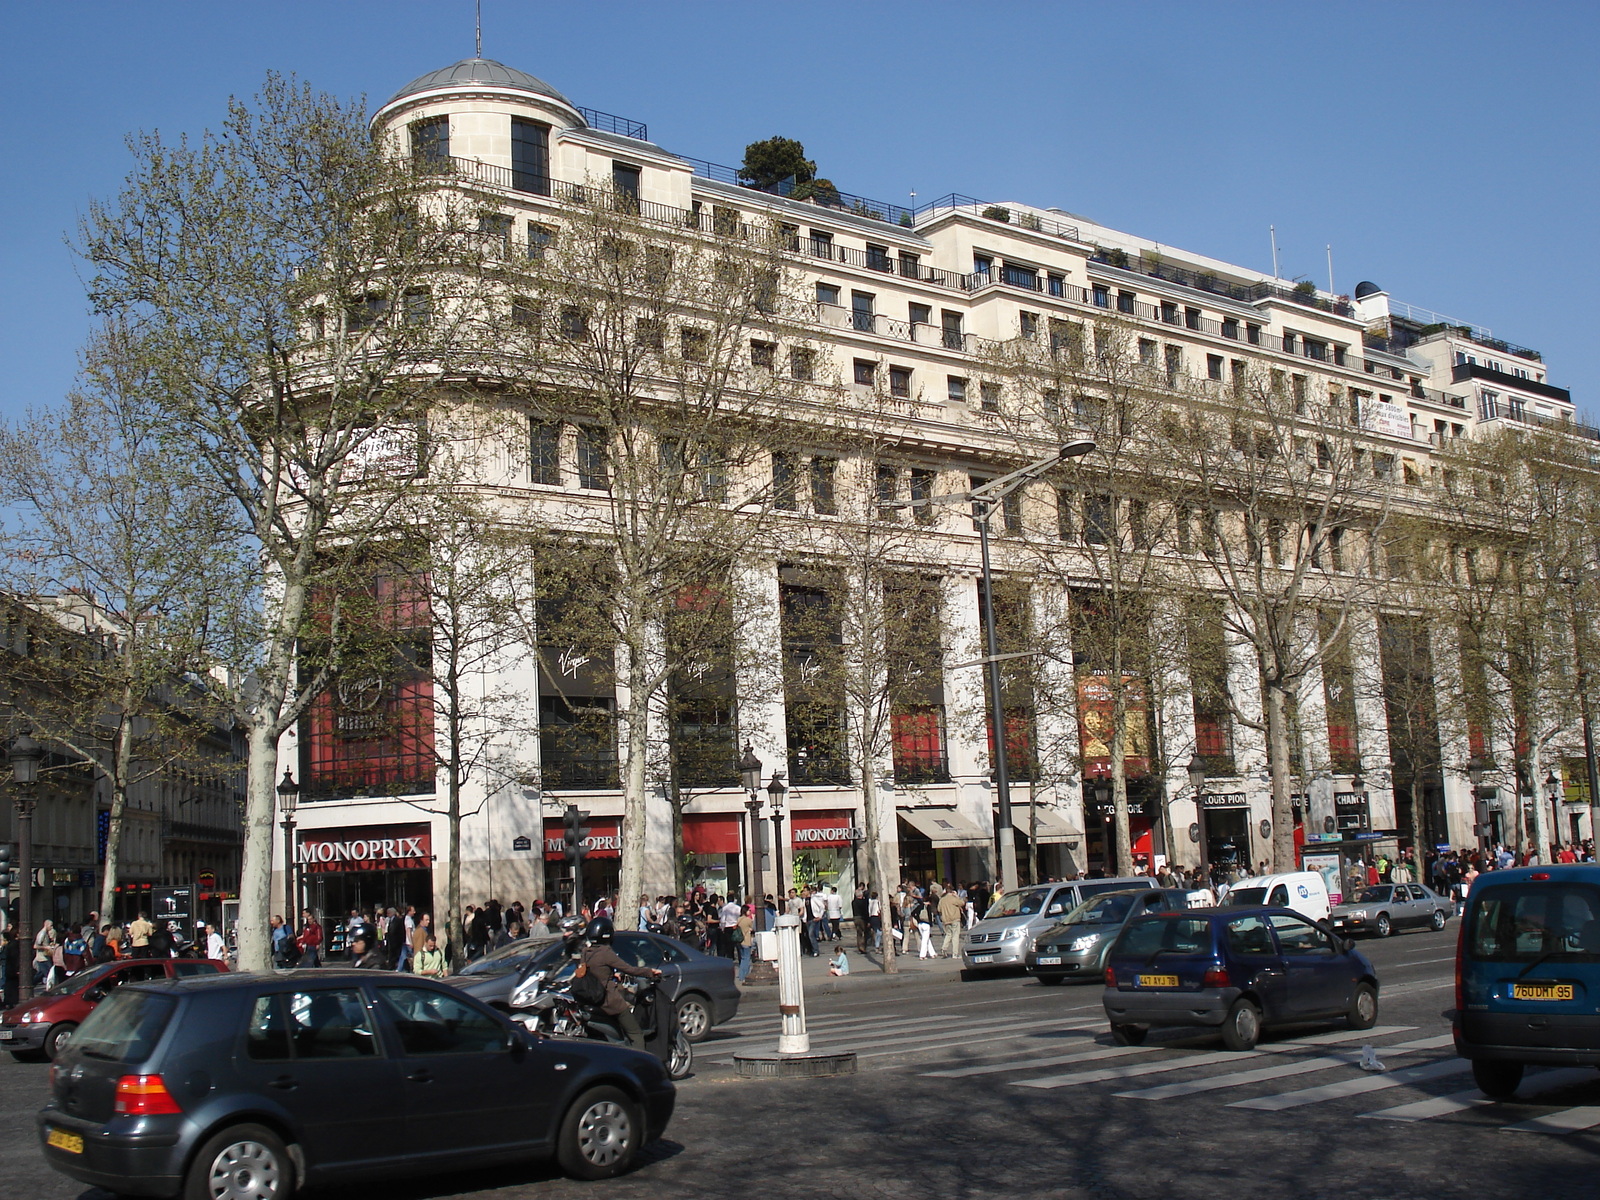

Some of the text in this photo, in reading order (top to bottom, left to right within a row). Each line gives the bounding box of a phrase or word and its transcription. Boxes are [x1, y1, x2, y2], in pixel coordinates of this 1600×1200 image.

[558, 645, 590, 680] Virgin
[1228, 794, 1245, 804] PION
[795, 827, 866, 842] MONOPRIX
[297, 837, 424, 864] MONOPRIX
[547, 836, 624, 852] MOPRI
[1140, 976, 1151, 985] 447
[1514, 985, 1534, 997] 760
[1557, 986, 1571, 998] 95
